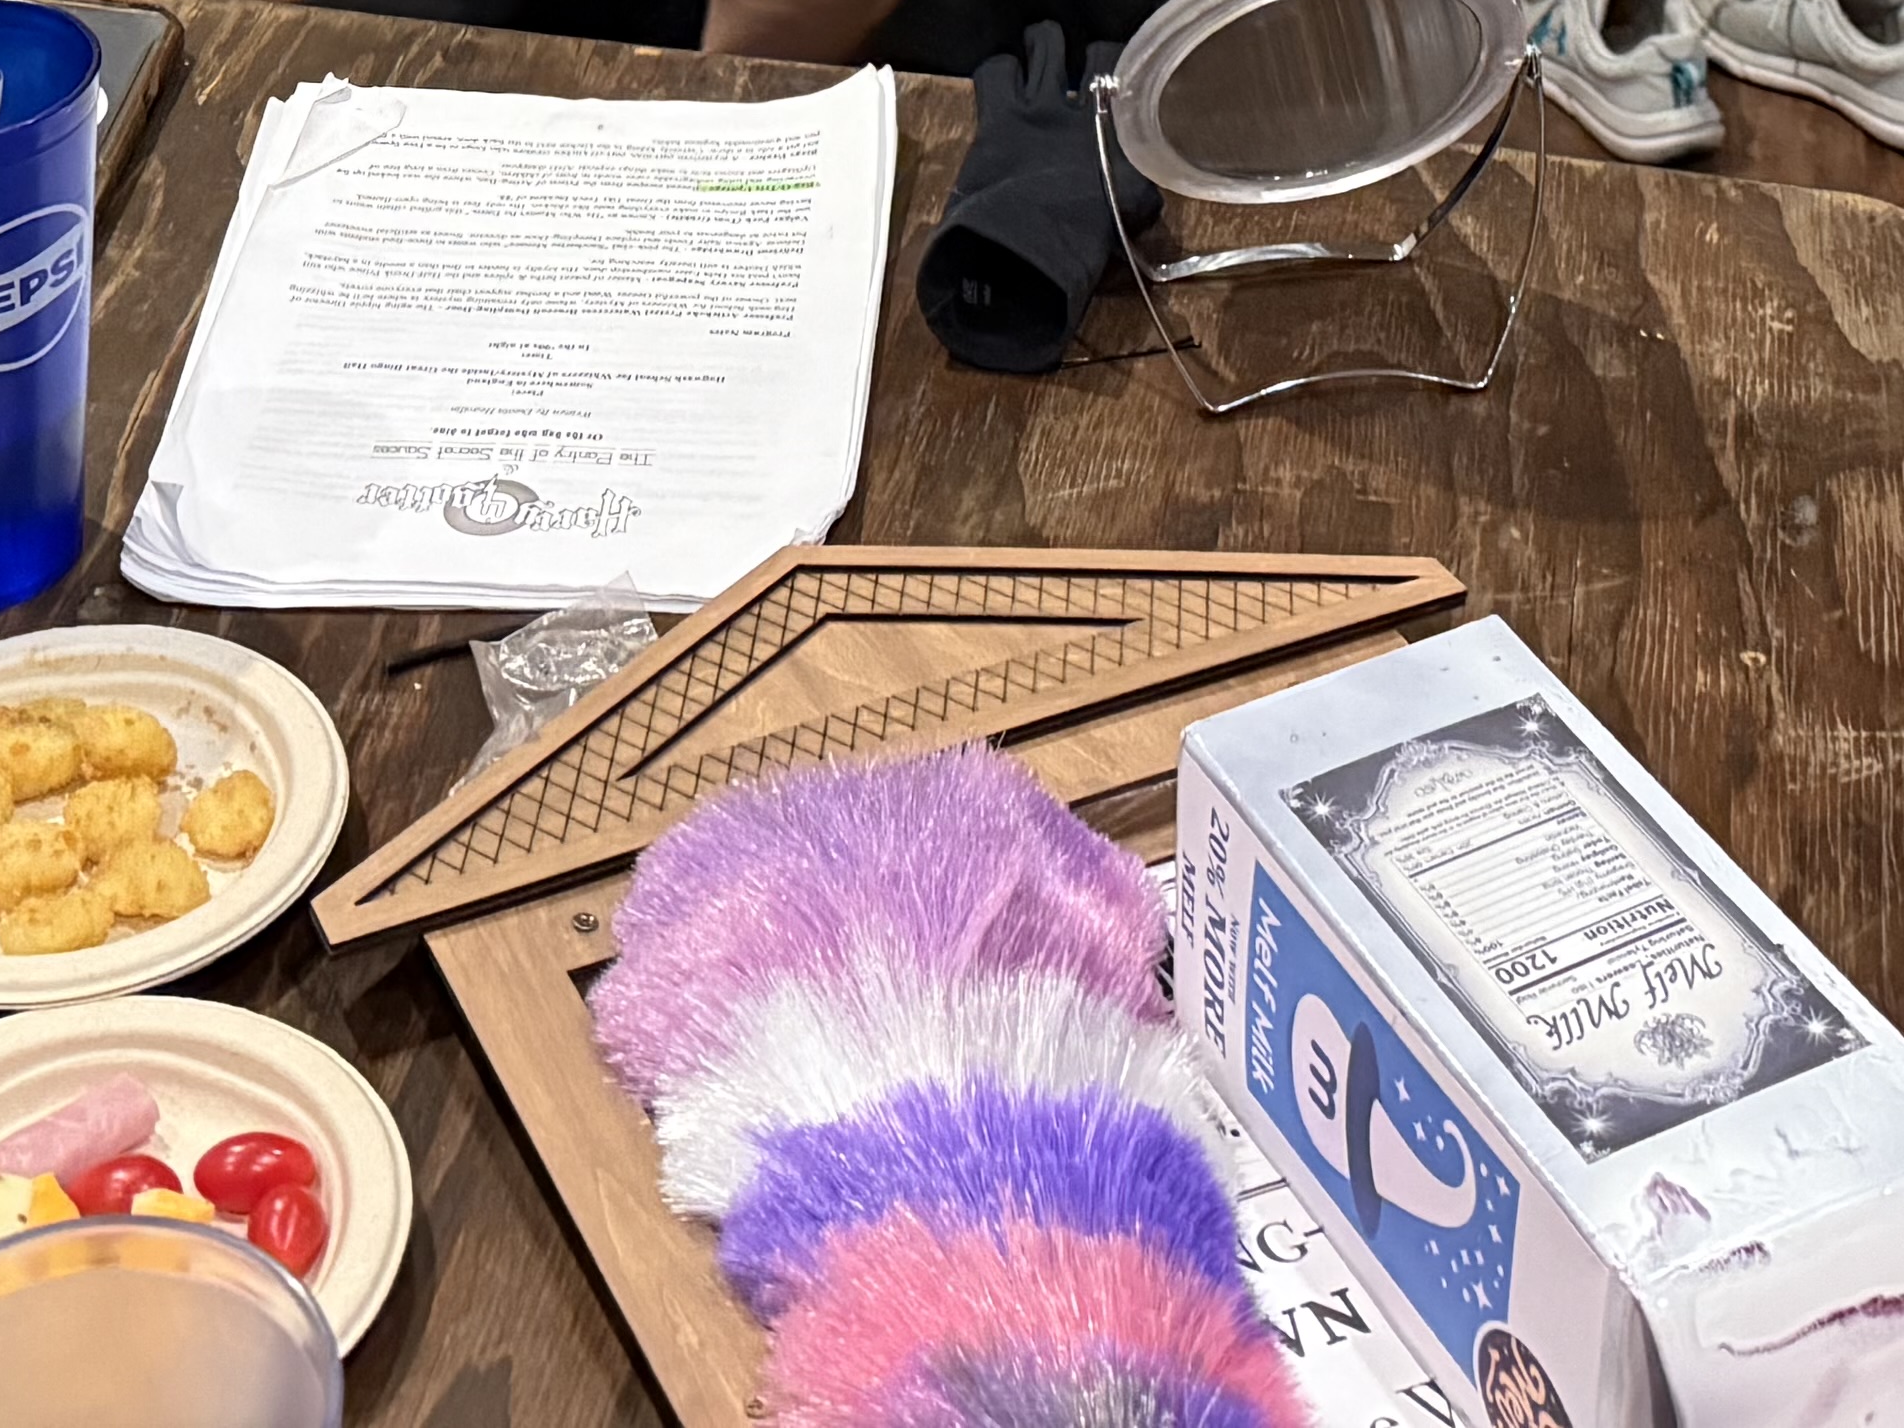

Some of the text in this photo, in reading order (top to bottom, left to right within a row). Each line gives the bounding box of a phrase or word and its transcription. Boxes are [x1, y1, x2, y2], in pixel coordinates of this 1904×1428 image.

[372, 444, 432, 459] Sauces
[437, 445, 494, 460] Secret
[530, 448, 549, 462] of
[555, 446, 613, 465] Pantry
[619, 452, 653, 466] The
[512, 488, 642, 538] Harry
[1180, 850, 1197, 950] MELF
[1202, 806, 1231, 1060] 20% MORE
[1582, 897, 1676, 941] Nutrition
[1487, 948, 1558, 985] 1200
[1252, 897, 1283, 1094] Melf Milk
